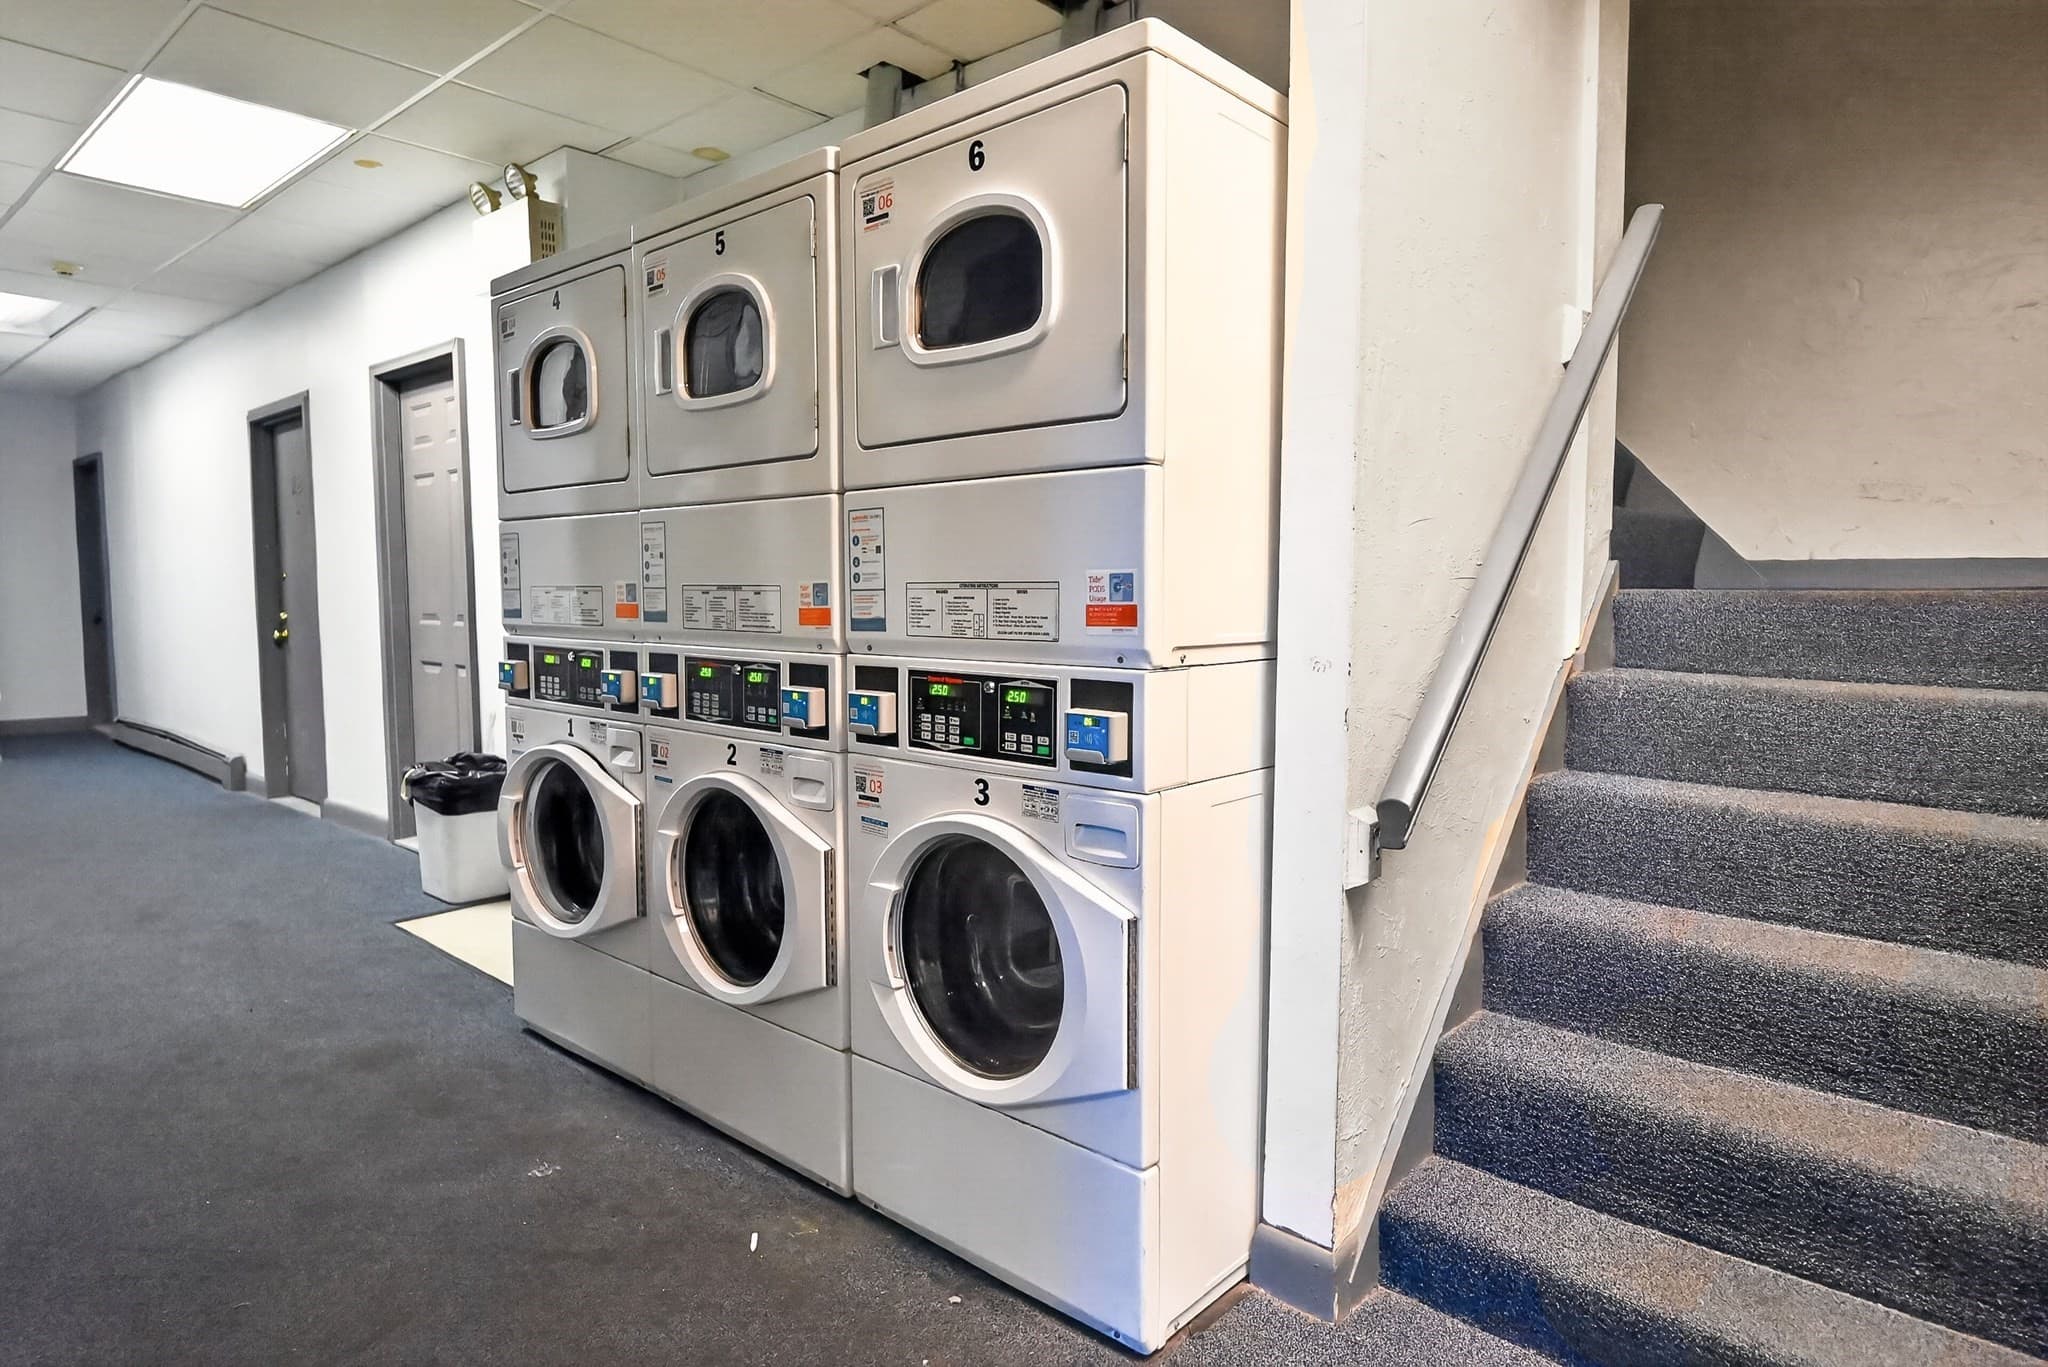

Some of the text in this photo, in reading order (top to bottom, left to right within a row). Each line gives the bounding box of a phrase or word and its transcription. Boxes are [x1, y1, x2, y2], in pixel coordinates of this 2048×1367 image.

[969, 140, 985, 171] 6
[878, 193, 893, 210] 06
[715, 230, 725, 255] 5
[656, 268, 666, 282] 05
[552, 290, 561, 310] 4
[567, 718, 574, 737] 1
[659, 745, 669, 758] 02
[727, 743, 737, 766] 2
[869, 779, 882, 793] 03
[974, 778, 990, 806] 3
